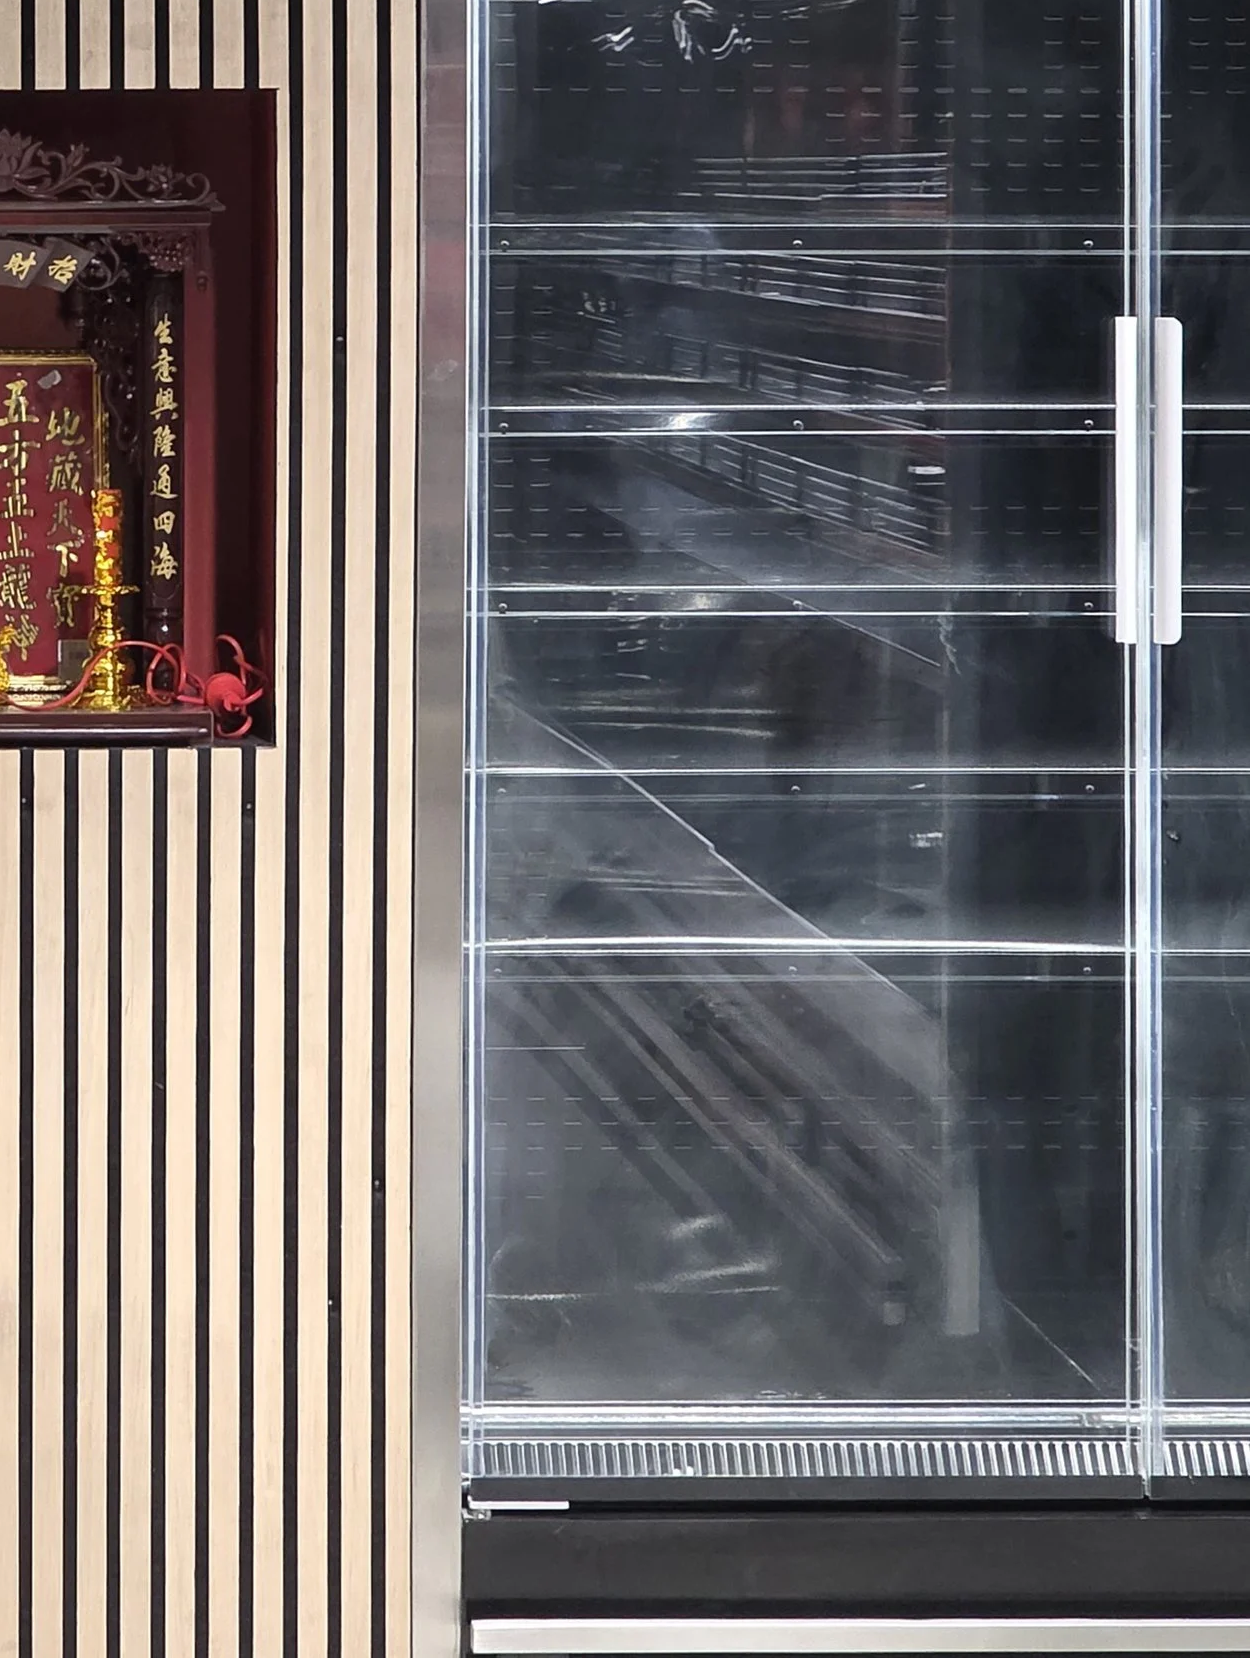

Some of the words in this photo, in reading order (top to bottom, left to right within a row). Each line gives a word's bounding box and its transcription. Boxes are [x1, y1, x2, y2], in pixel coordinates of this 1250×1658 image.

[149, 313, 179, 581] 生意興隆通四海
